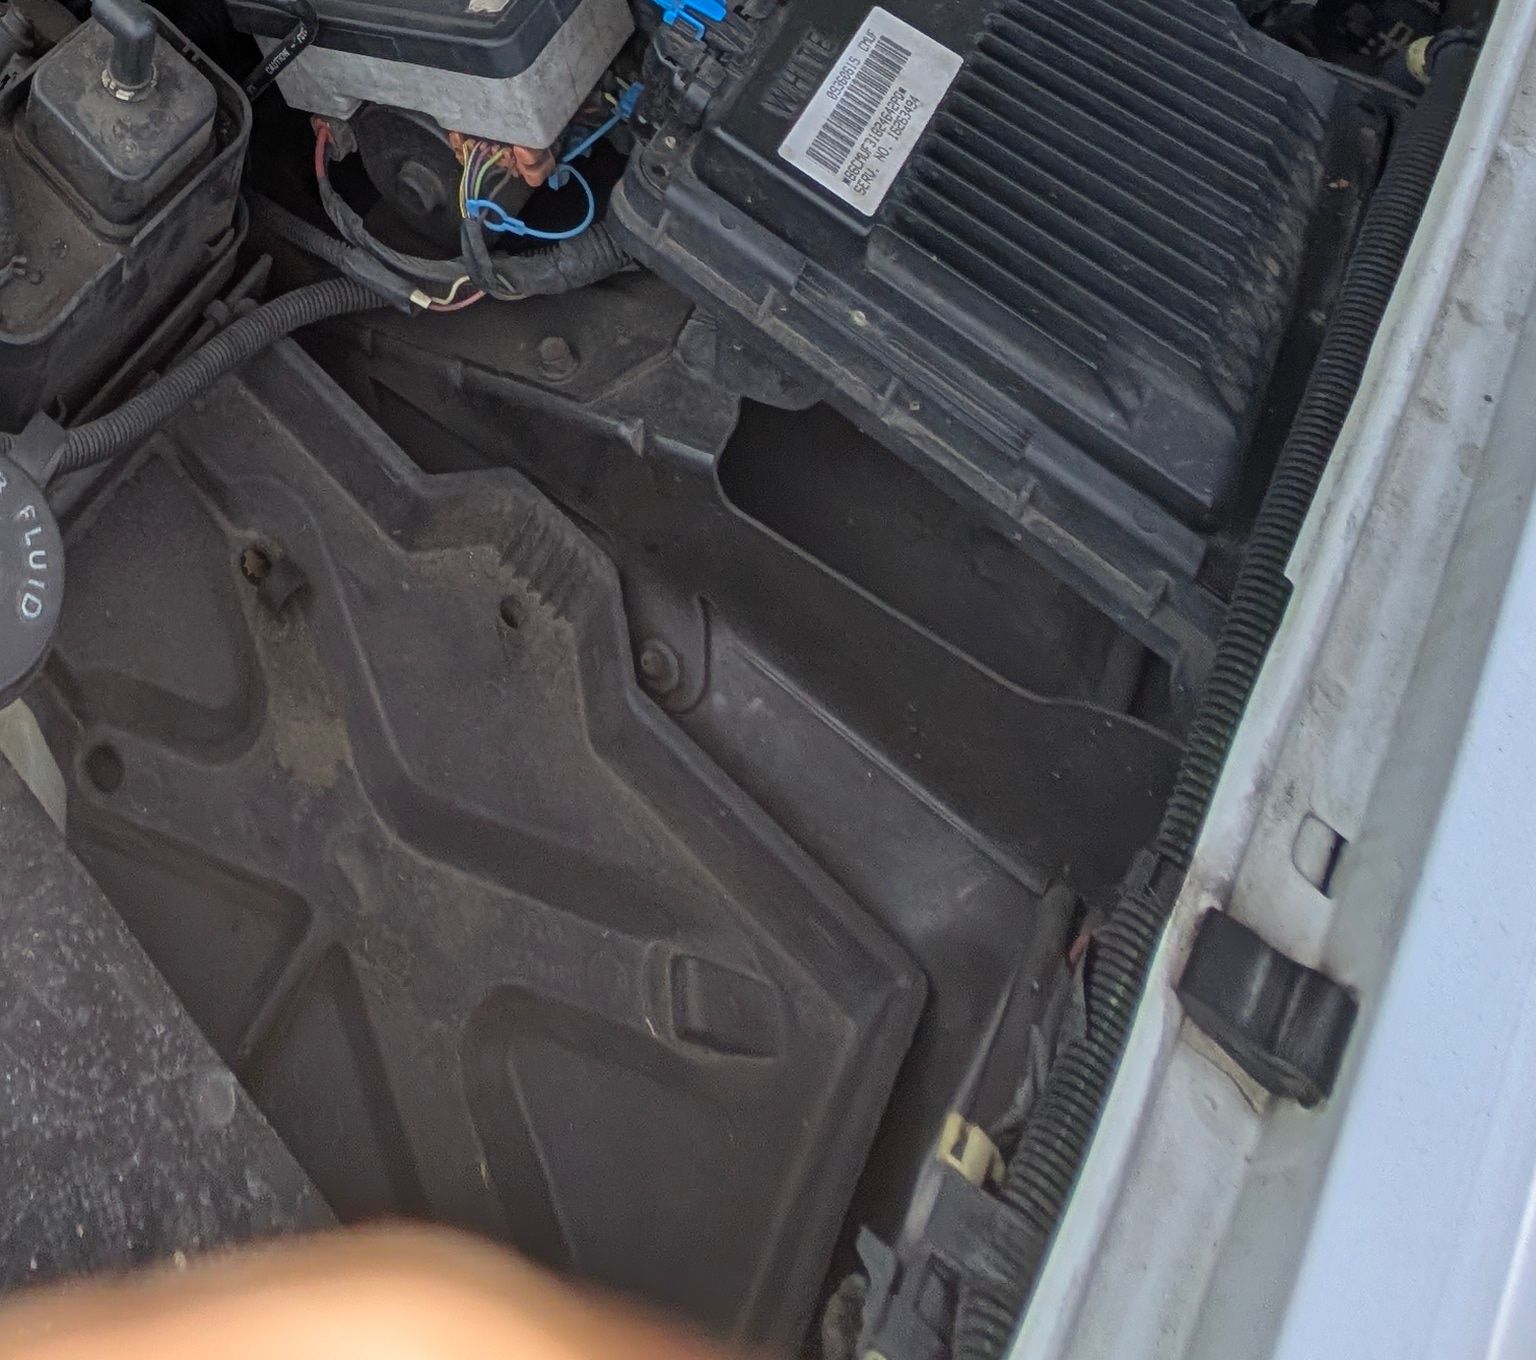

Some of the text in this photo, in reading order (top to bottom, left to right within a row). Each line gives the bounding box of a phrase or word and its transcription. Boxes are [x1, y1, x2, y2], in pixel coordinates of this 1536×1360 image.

[264, 48, 290, 75] CAUTION
[858, 29, 879, 53] CMUF
[763, 29, 833, 118] WHITE
[854, 167, 881, 195] SERV.
[873, 144, 894, 162] NO.
[17, 504, 48, 619] FLUID
